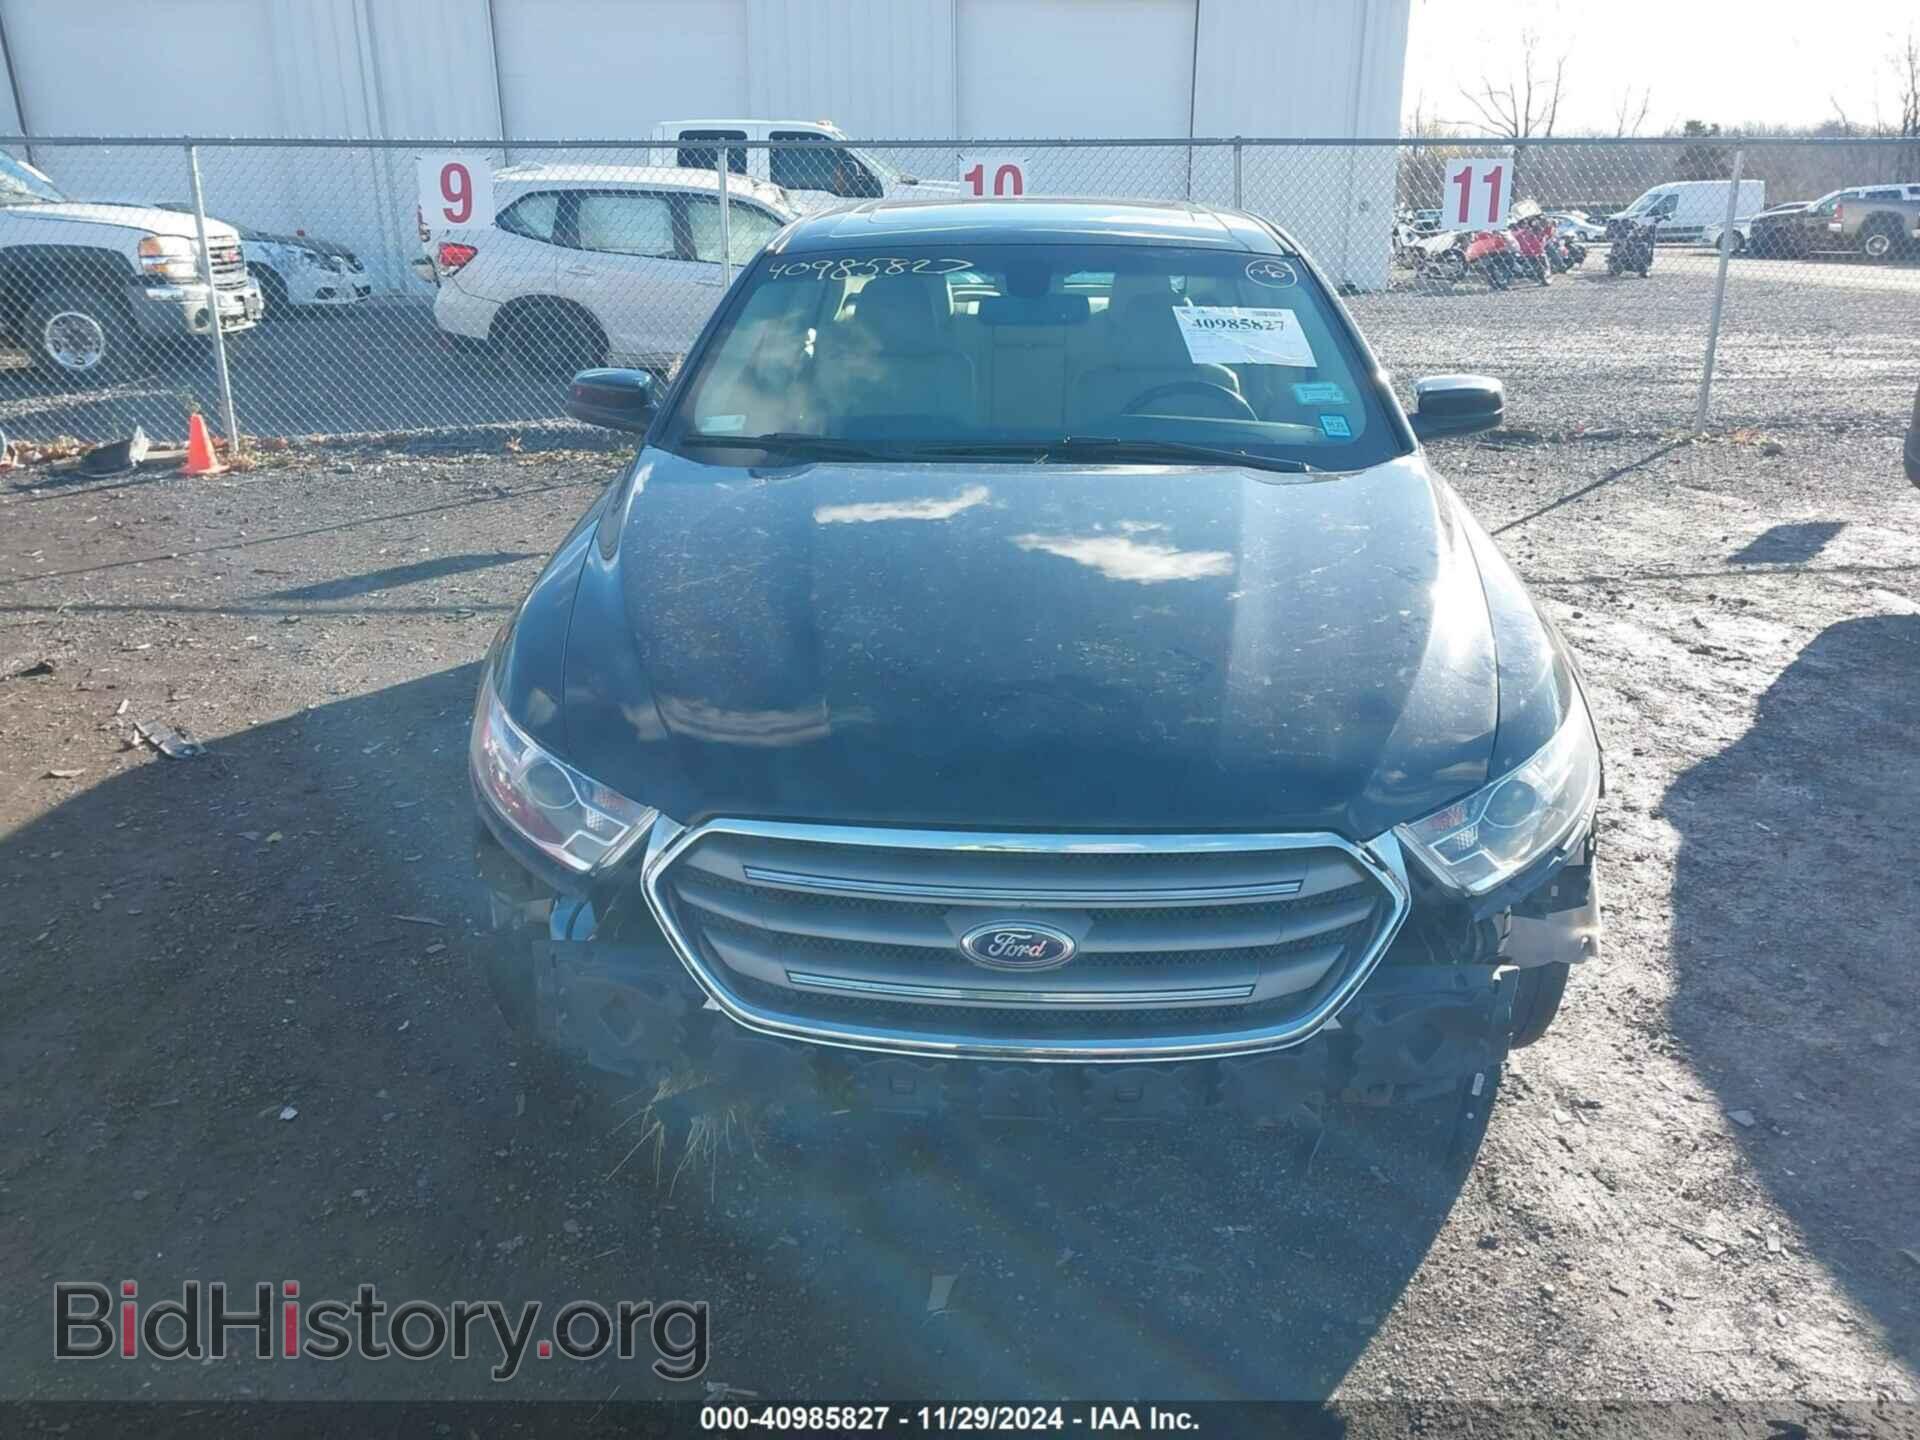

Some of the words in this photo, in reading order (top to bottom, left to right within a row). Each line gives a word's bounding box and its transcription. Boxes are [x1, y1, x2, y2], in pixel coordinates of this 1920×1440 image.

[440, 162, 472, 223] 9
[1453, 166, 1503, 223] 11
[769, 258, 974, 281] 40985827
[1192, 318, 1285, 331] 40985827
[988, 932, 1047, 957] Ford
